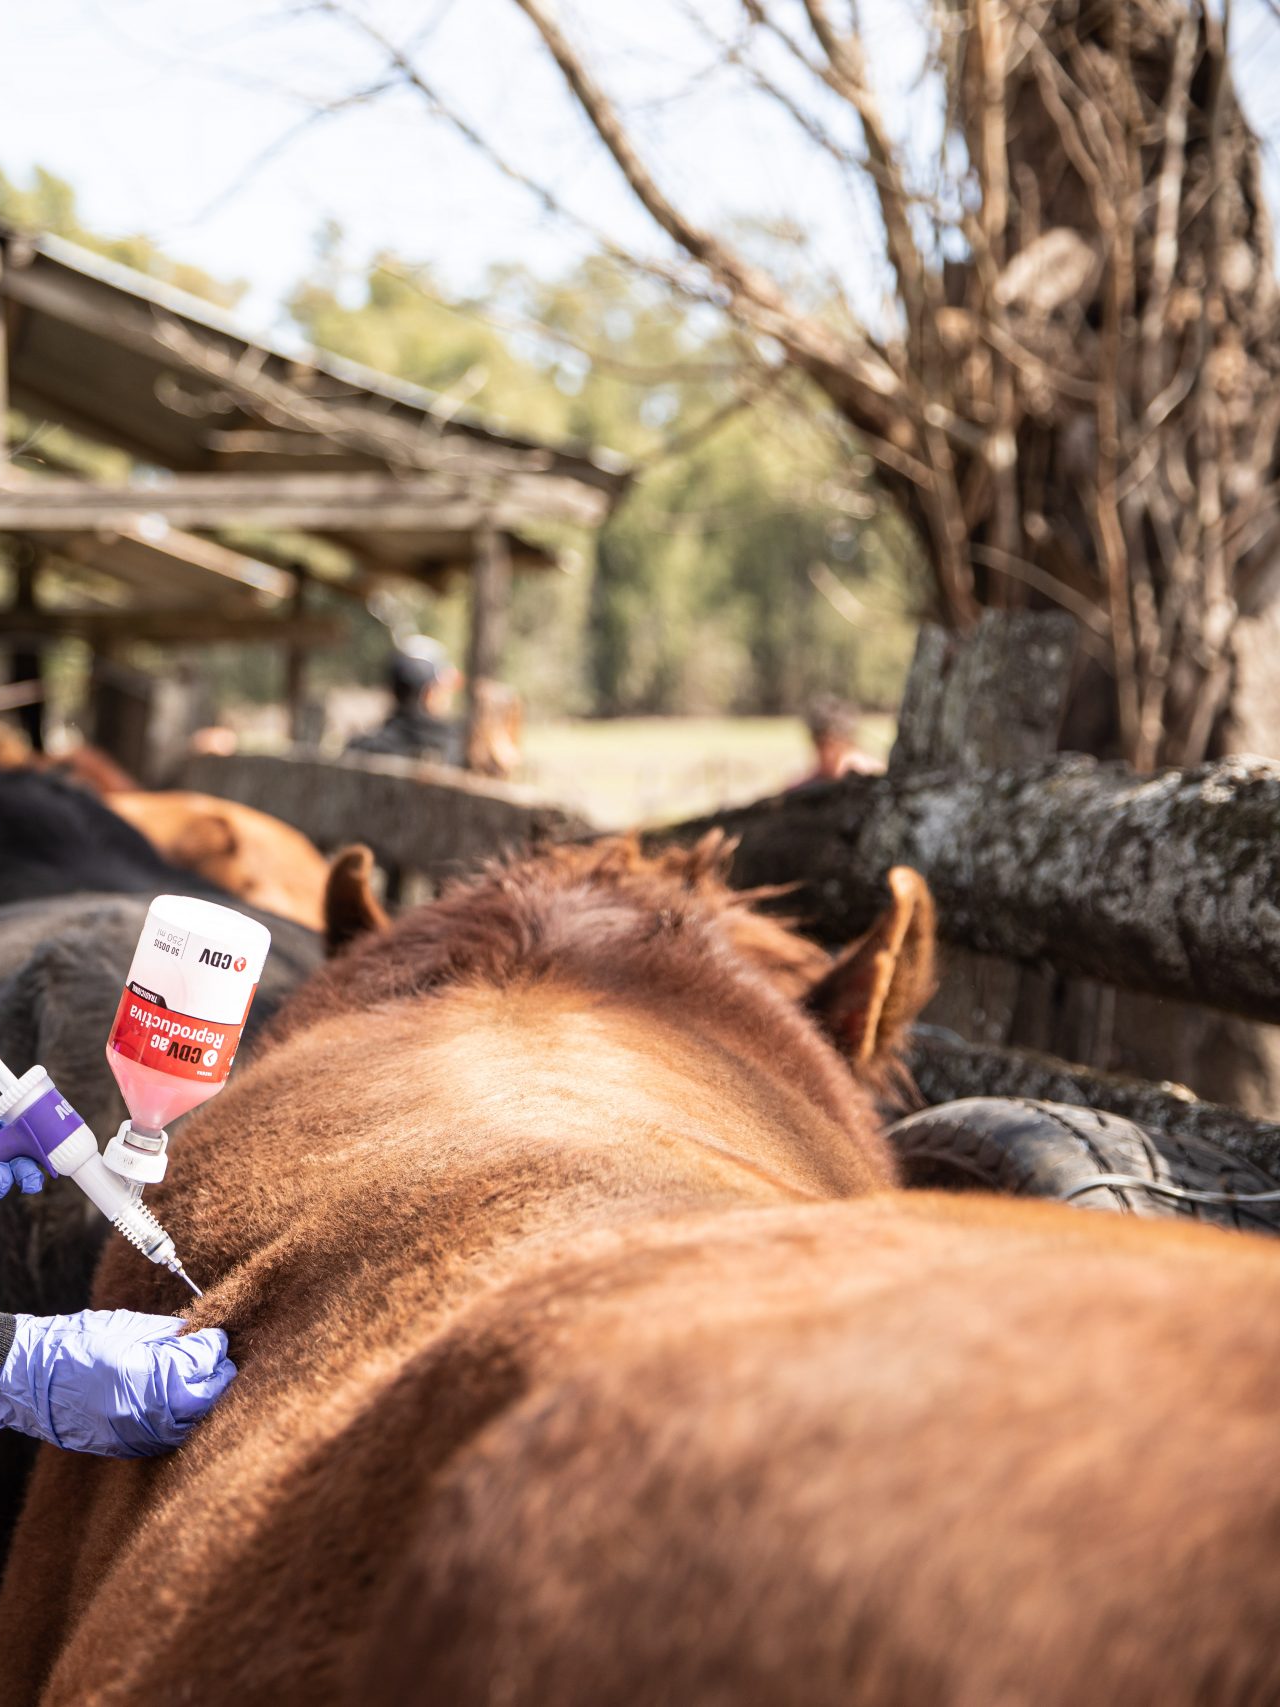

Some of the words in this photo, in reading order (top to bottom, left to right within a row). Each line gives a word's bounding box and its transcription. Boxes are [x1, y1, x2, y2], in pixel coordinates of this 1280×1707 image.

[154, 939, 170, 953] DOSIS
[167, 933, 183, 946] 250
[171, 946, 180, 957] 50
[198, 948, 233, 970] CDV
[129, 1004, 225, 1049] Reproductiva
[150, 1034, 203, 1064] CDVac
